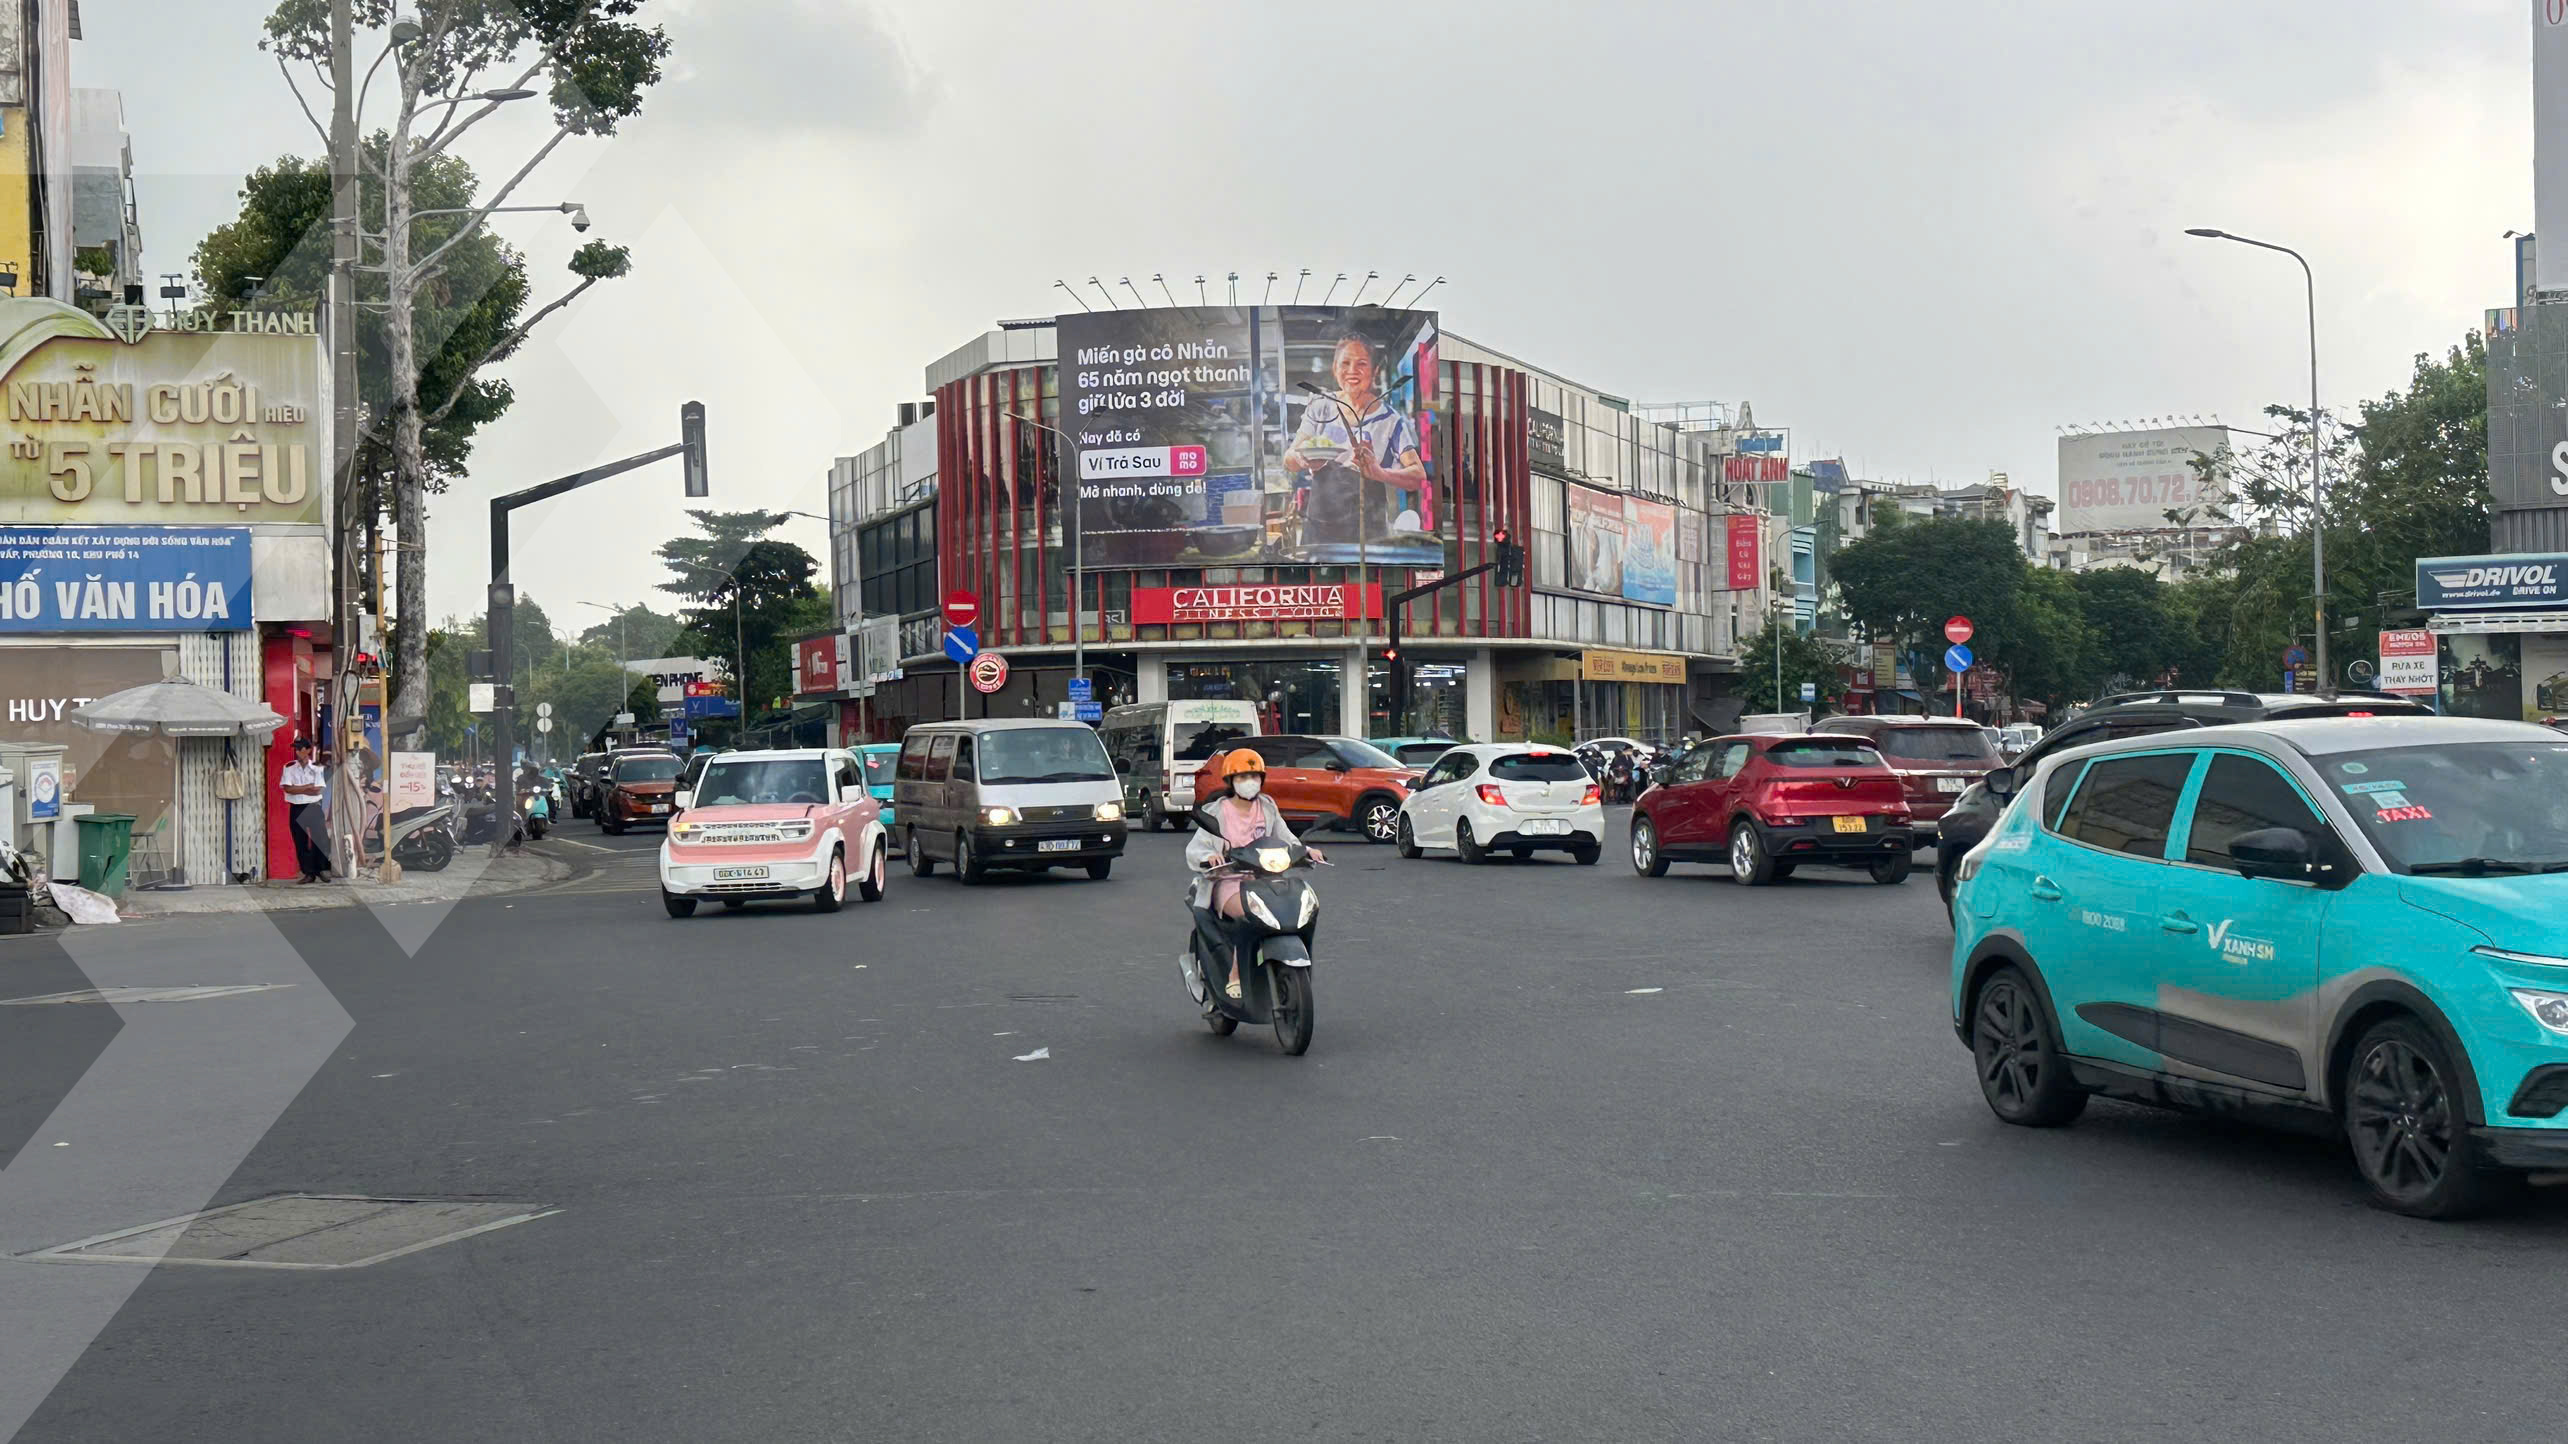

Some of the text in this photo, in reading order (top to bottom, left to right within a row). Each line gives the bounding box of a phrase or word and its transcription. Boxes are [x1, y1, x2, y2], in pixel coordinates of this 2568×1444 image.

[166, 310, 315, 334] HUY THANH
[1078, 345, 1119, 365] Miến
[1123, 345, 1147, 366] gà
[1150, 344, 1174, 361] cô
[1078, 366, 1250, 388] 65 năm ngọt thanh
[8, 360, 133, 422] NHẪN
[149, 369, 257, 424] CƯỚI
[1108, 388, 1137, 410] lửa
[1140, 392, 1151, 408] 3
[1155, 390, 1185, 407] đời
[1080, 428, 1140, 445] Nay đã có
[9, 429, 307, 511] TỪ 5 TRIỆU
[1132, 456, 1161, 468] Sau
[1103, 484, 1146, 497] nhanh,
[1149, 482, 1182, 497] dùng
[105, 549, 125, 559] PHỐ
[2465, 565, 2556, 587] DRIVOL
[55, 572, 136, 620] VĂN
[149, 571, 230, 620] HÓA
[1173, 587, 1343, 608] CALIFORNIA
[2513, 586, 2557, 595] DRIVE ON
[1174, 608, 1260, 619] FITNESS
[2384, 675, 2406, 684] THAY
[9, 699, 66, 722] HUY
[2377, 805, 2432, 822] TAXI
[2224, 937, 2257, 956] XANH
[2258, 943, 2275, 960] SM
